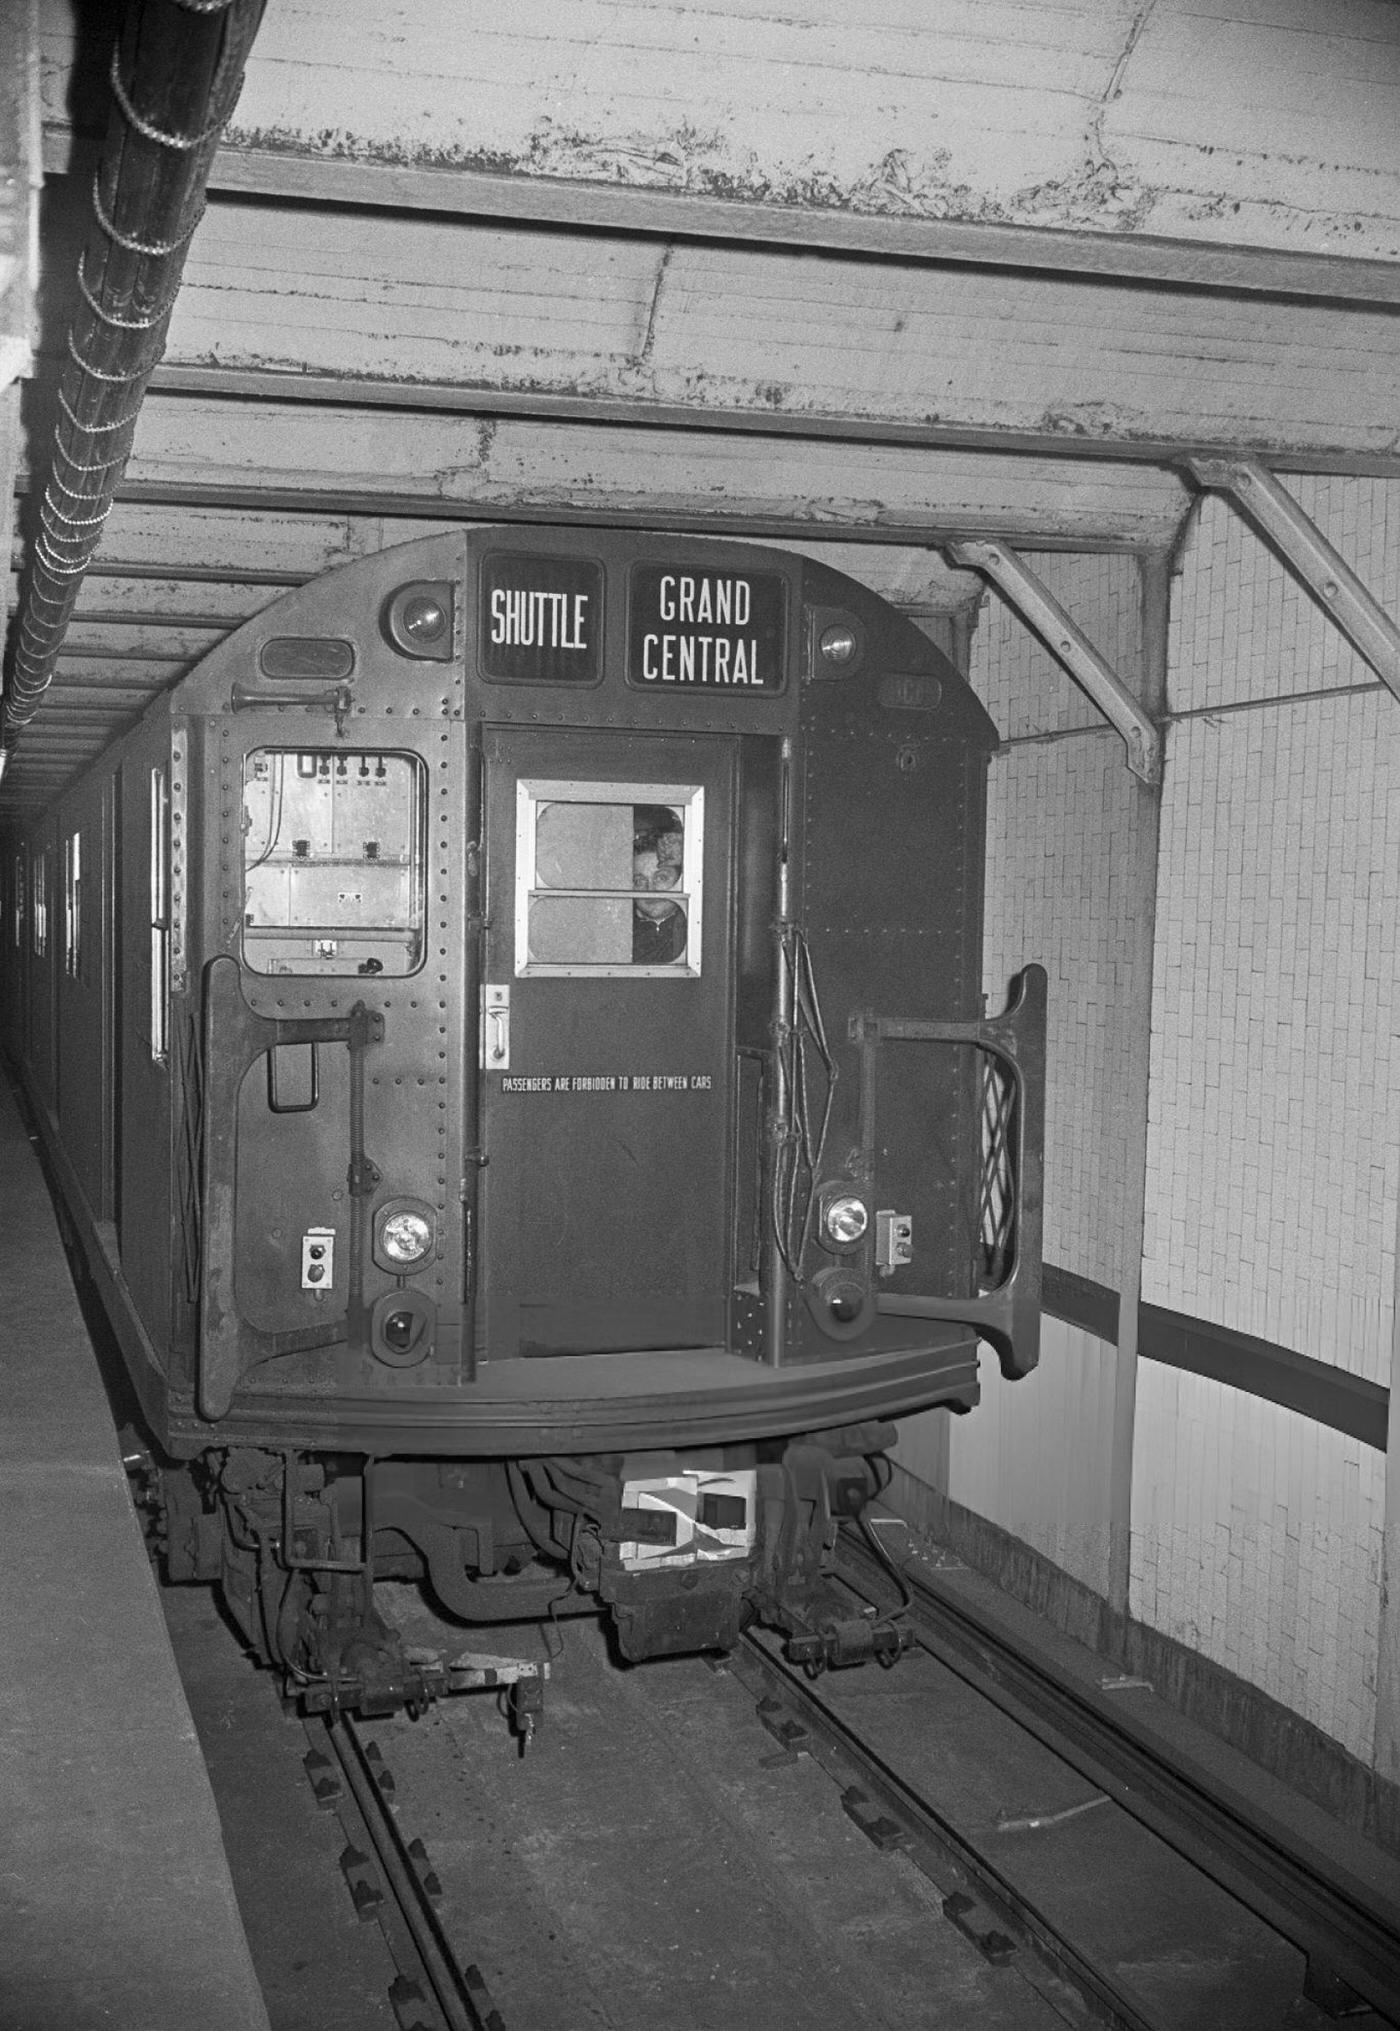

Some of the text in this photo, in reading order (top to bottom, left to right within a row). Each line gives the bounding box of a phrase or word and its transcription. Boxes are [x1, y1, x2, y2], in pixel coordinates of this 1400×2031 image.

[491, 588, 588, 649] SHUTTLE
[660, 576, 750, 625] GRAND
[643, 634, 764, 685] CENTRAL
[502, 1076, 712, 1092] PASSENGERS ARE FORBIDDEN TO RIDE BETWEEN CARS
